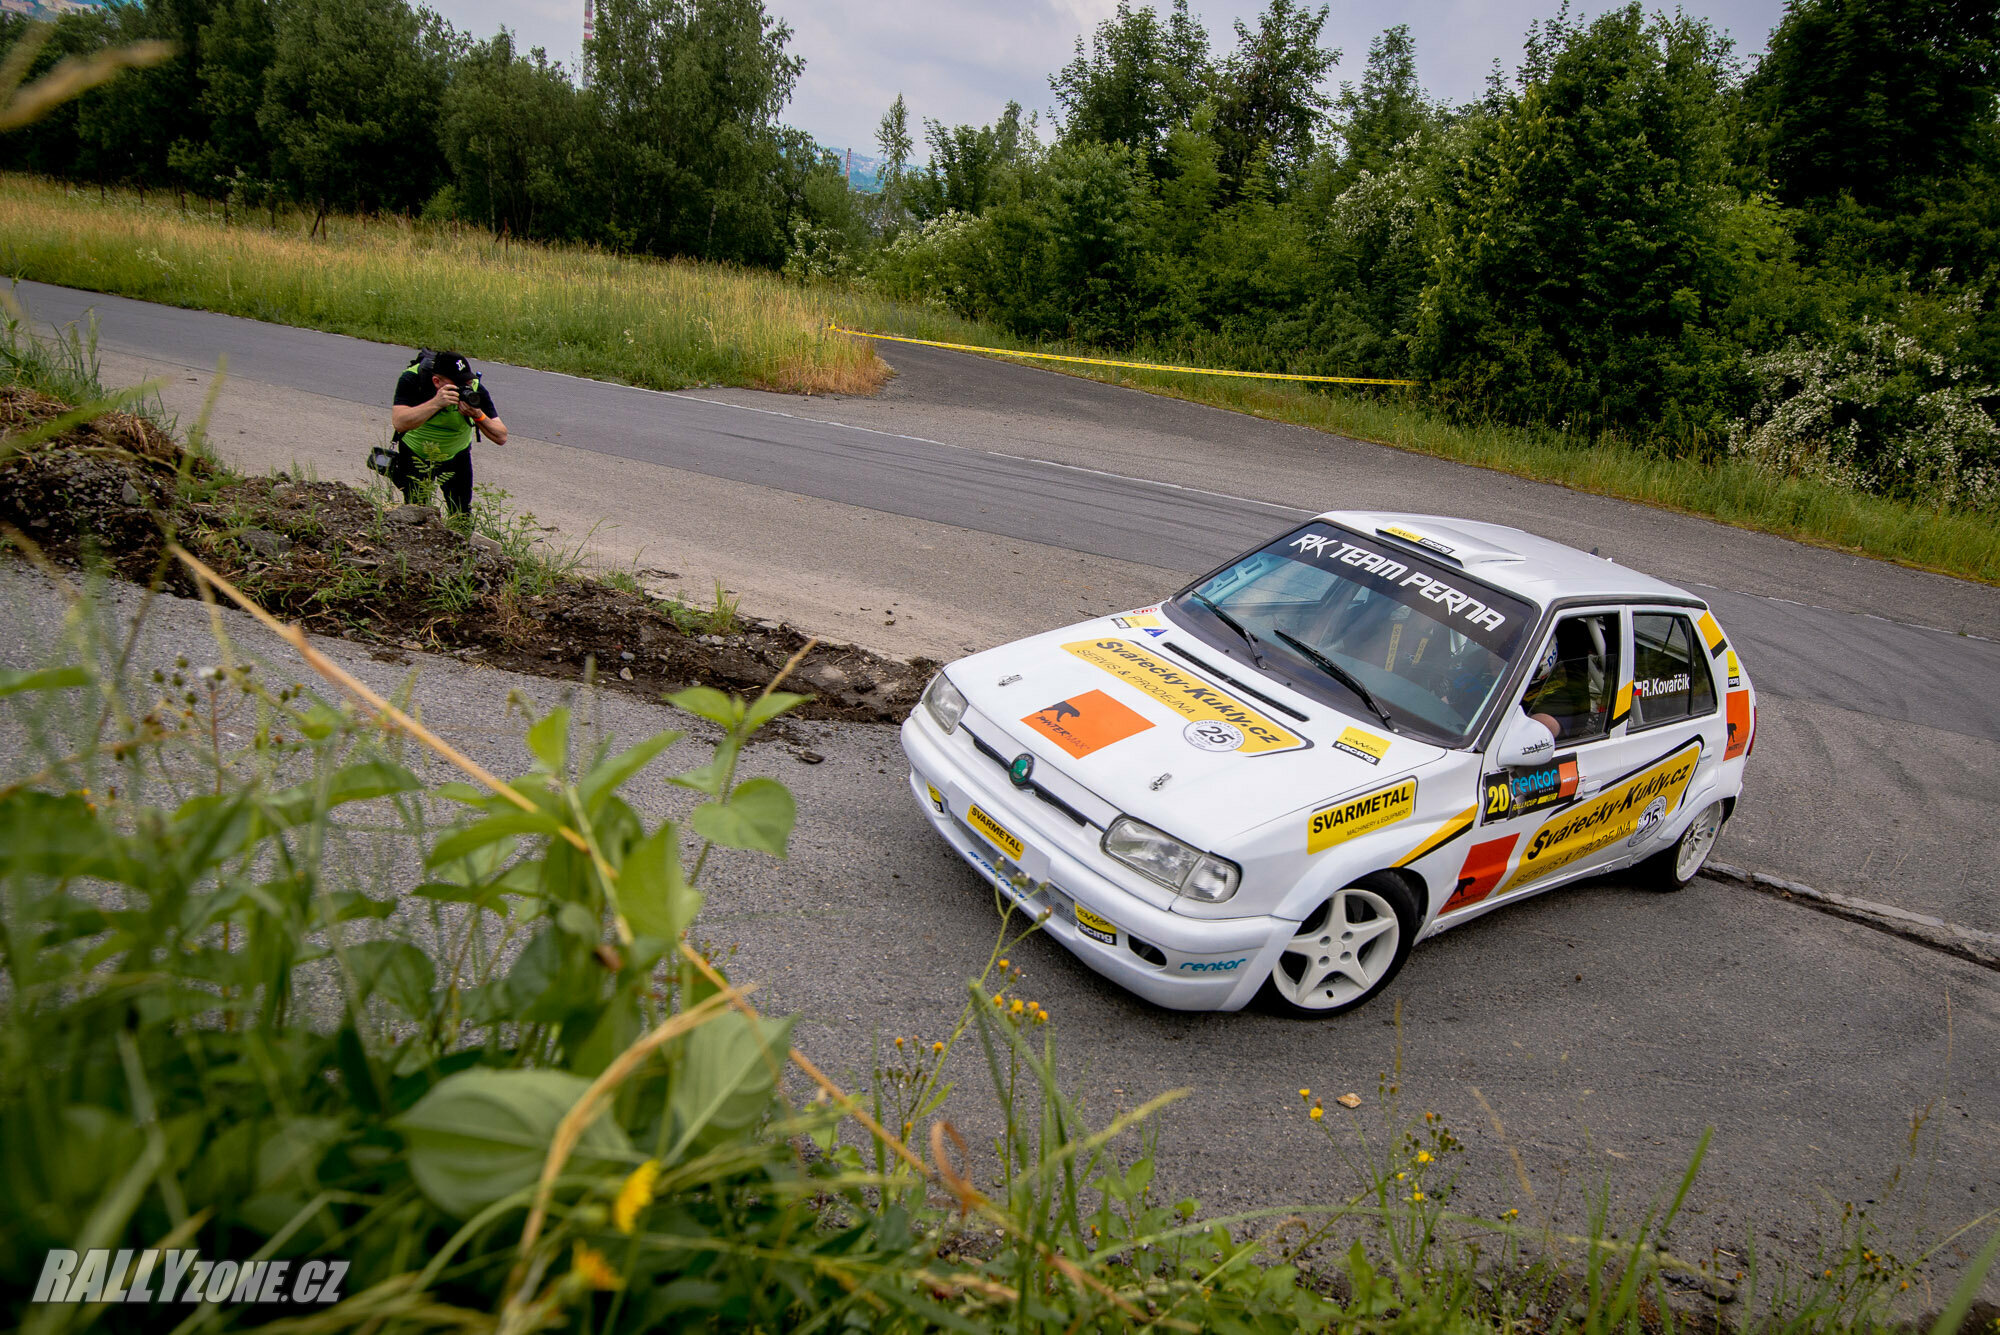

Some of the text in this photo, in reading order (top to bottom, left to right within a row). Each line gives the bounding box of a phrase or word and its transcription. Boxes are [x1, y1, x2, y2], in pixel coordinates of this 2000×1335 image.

[1289, 533, 1506, 632] RK TEAM PERNA
[1077, 649, 1118, 675] SERVIS
[1130, 675, 1196, 714] PRODEJNA
[1196, 726, 1235, 744] 25
[1335, 742, 1377, 764] racing
[1512, 769, 1558, 796] rentor
[1313, 787, 1410, 833] SVARMETAL
[1487, 783, 1510, 814] 20
[1528, 764, 1690, 860] Svářečky-Kukly.cz
[971, 807, 1021, 852] SVARMETAL
[1347, 820, 1376, 836] MACHINERY
[1381, 808, 1409, 823] EQUIPMENT
[1636, 806, 1661, 836] 25
[1571, 820, 1631, 861] PRODEJNA
[1077, 920, 1113, 944] racing
[1179, 958, 1247, 972] rentor
